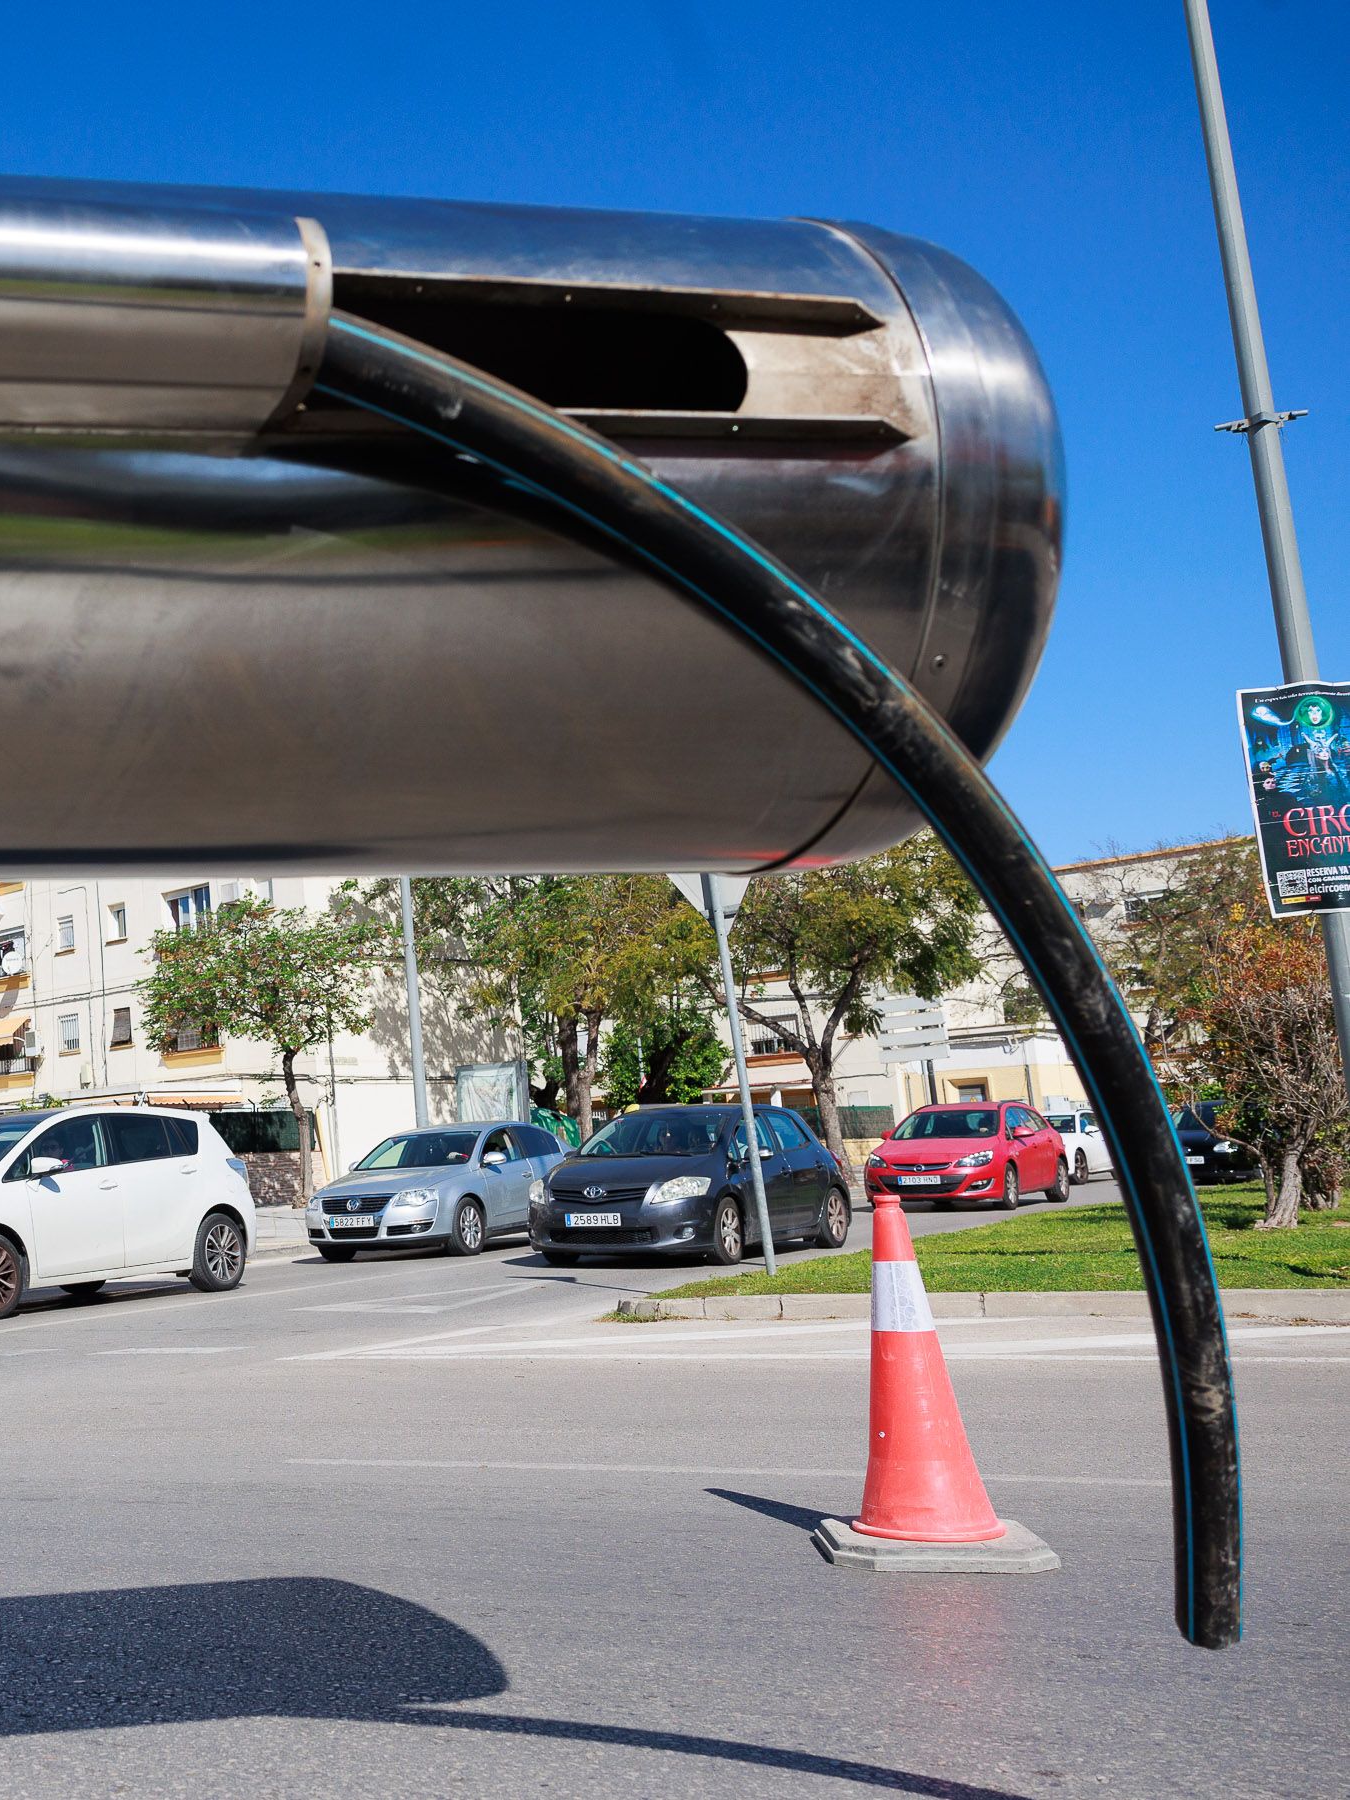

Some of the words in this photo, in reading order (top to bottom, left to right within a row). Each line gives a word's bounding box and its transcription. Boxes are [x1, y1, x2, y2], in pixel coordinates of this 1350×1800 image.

[1306, 866, 1338, 877] RESERVA
[1338, 865, 1349, 875] YA
[335, 1217, 354, 1227] 5822
[574, 1216, 598, 1225] 2589
[600, 1214, 619, 1224] HLB
